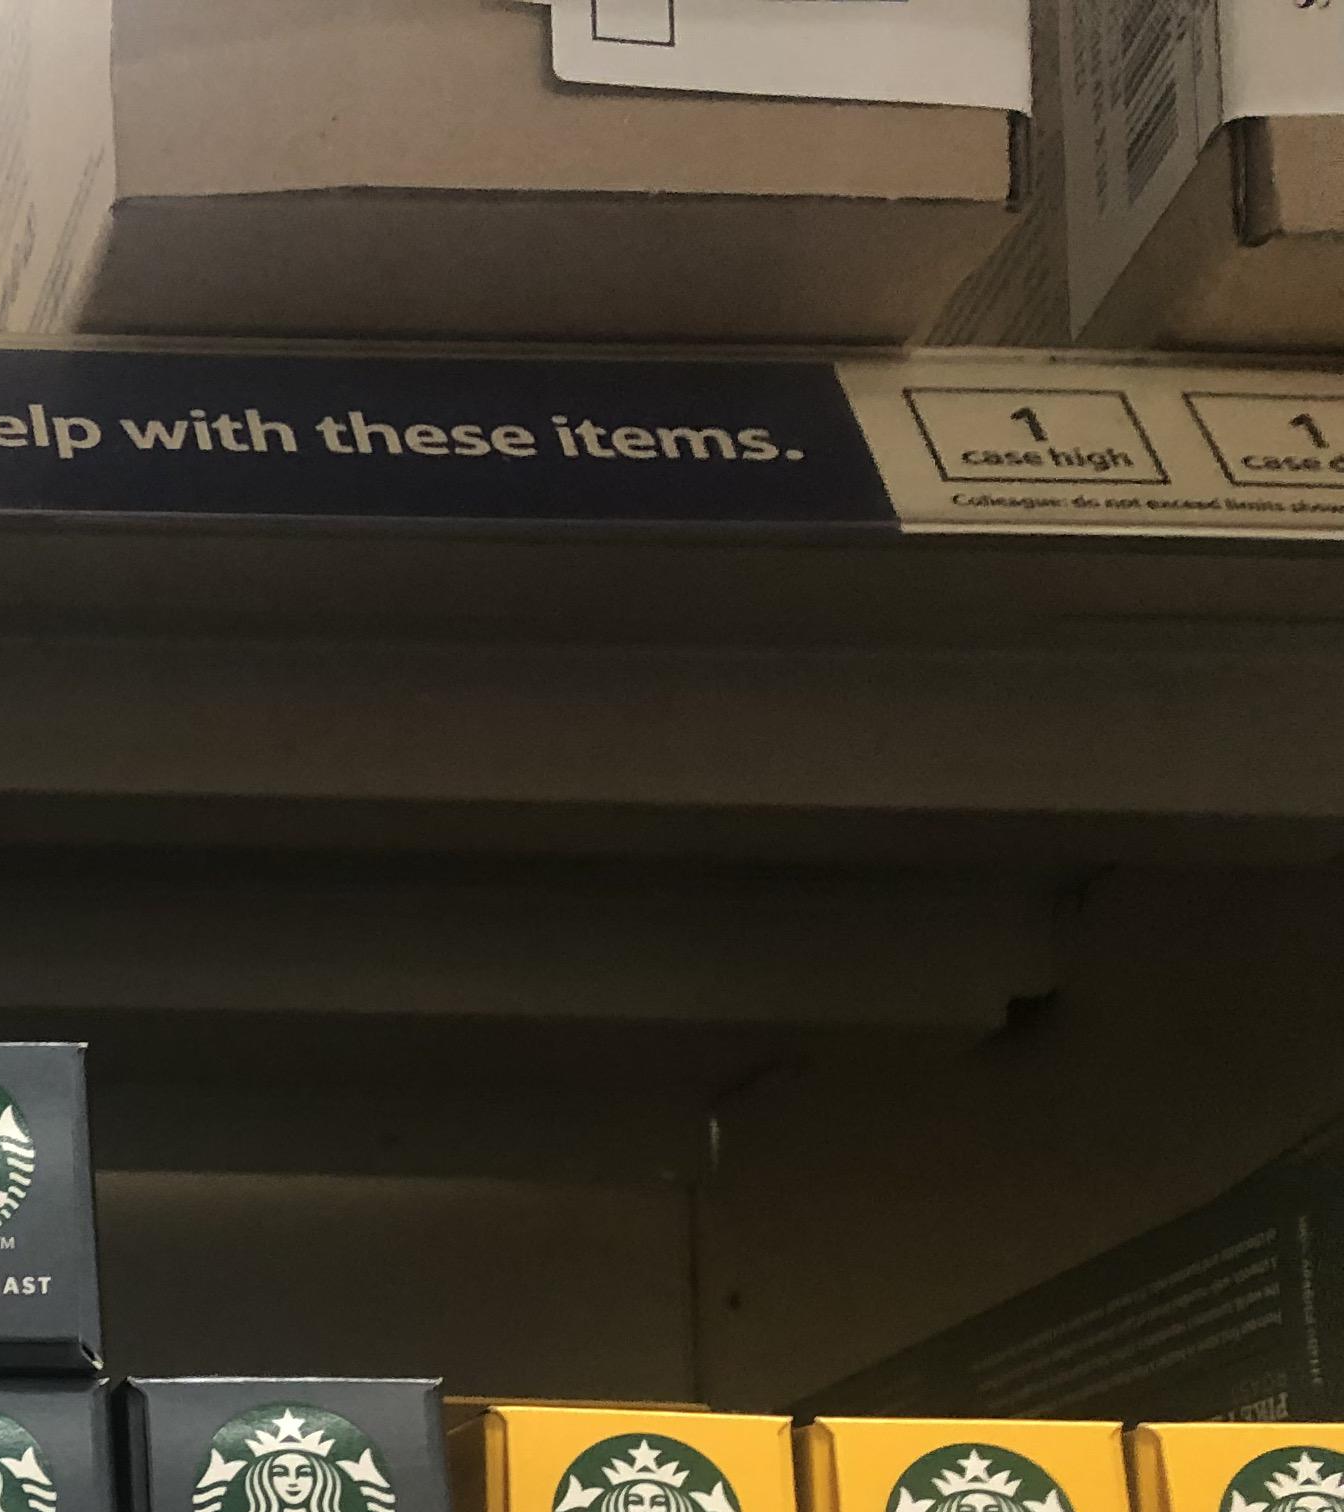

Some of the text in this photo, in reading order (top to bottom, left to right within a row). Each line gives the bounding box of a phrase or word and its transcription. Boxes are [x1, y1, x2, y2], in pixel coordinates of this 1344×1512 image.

[120, 409, 297, 451] with
[316, 411, 537, 457] these
[552, 416, 803, 460] items.
[1011, 406, 1048, 442] 1
[1289, 413, 1330, 449] 1
[961, 447, 1134, 472] case high
[1242, 455, 1321, 471] case
